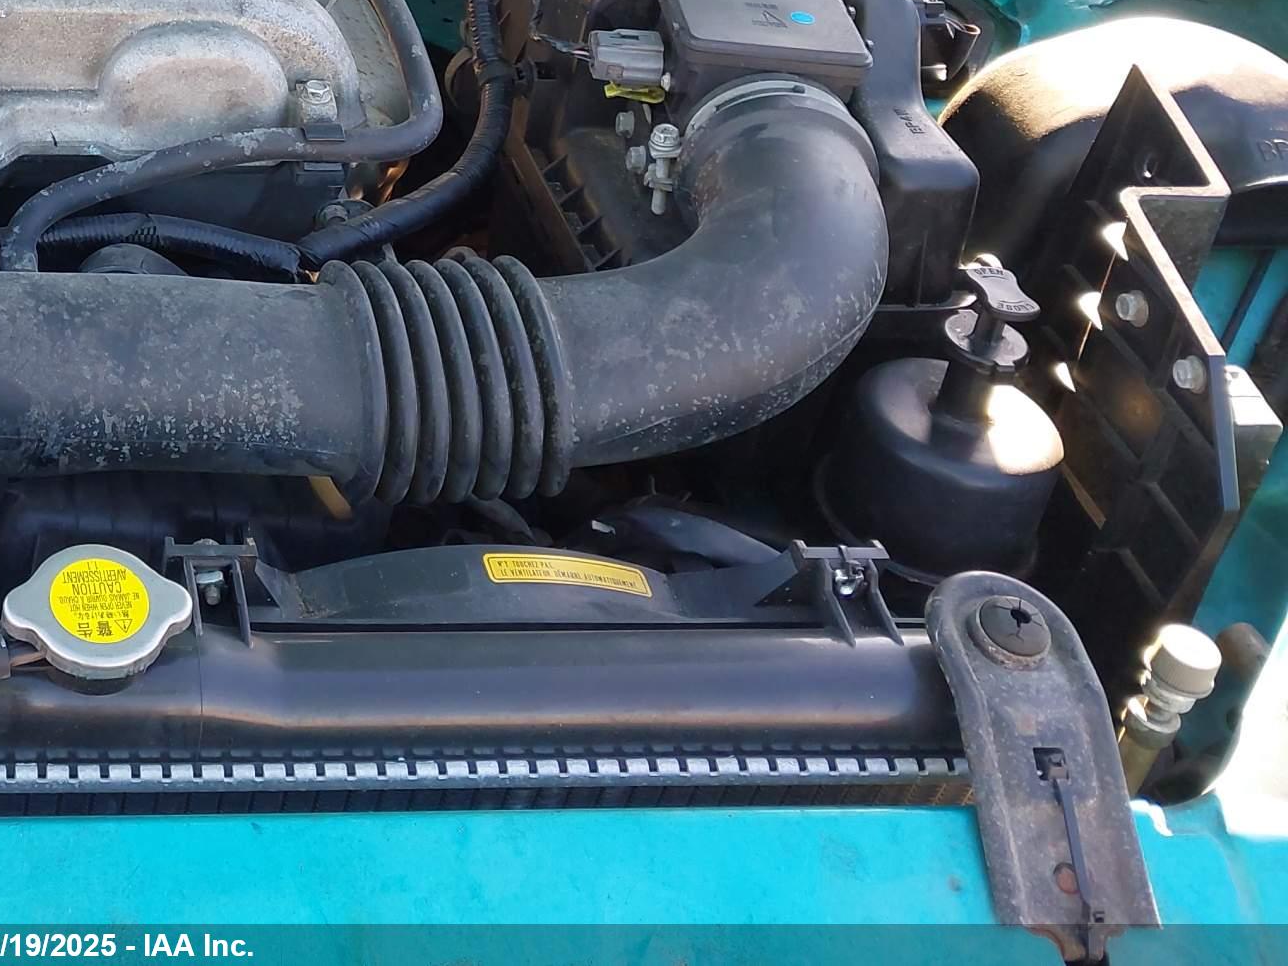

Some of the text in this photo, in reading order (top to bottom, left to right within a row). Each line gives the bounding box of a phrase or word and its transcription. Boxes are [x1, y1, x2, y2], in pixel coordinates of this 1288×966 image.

[974, 267, 1004, 275] OPEN
[63, 569, 127, 584] AVERTISSEMENT
[71, 581, 122, 595] CAUTION
